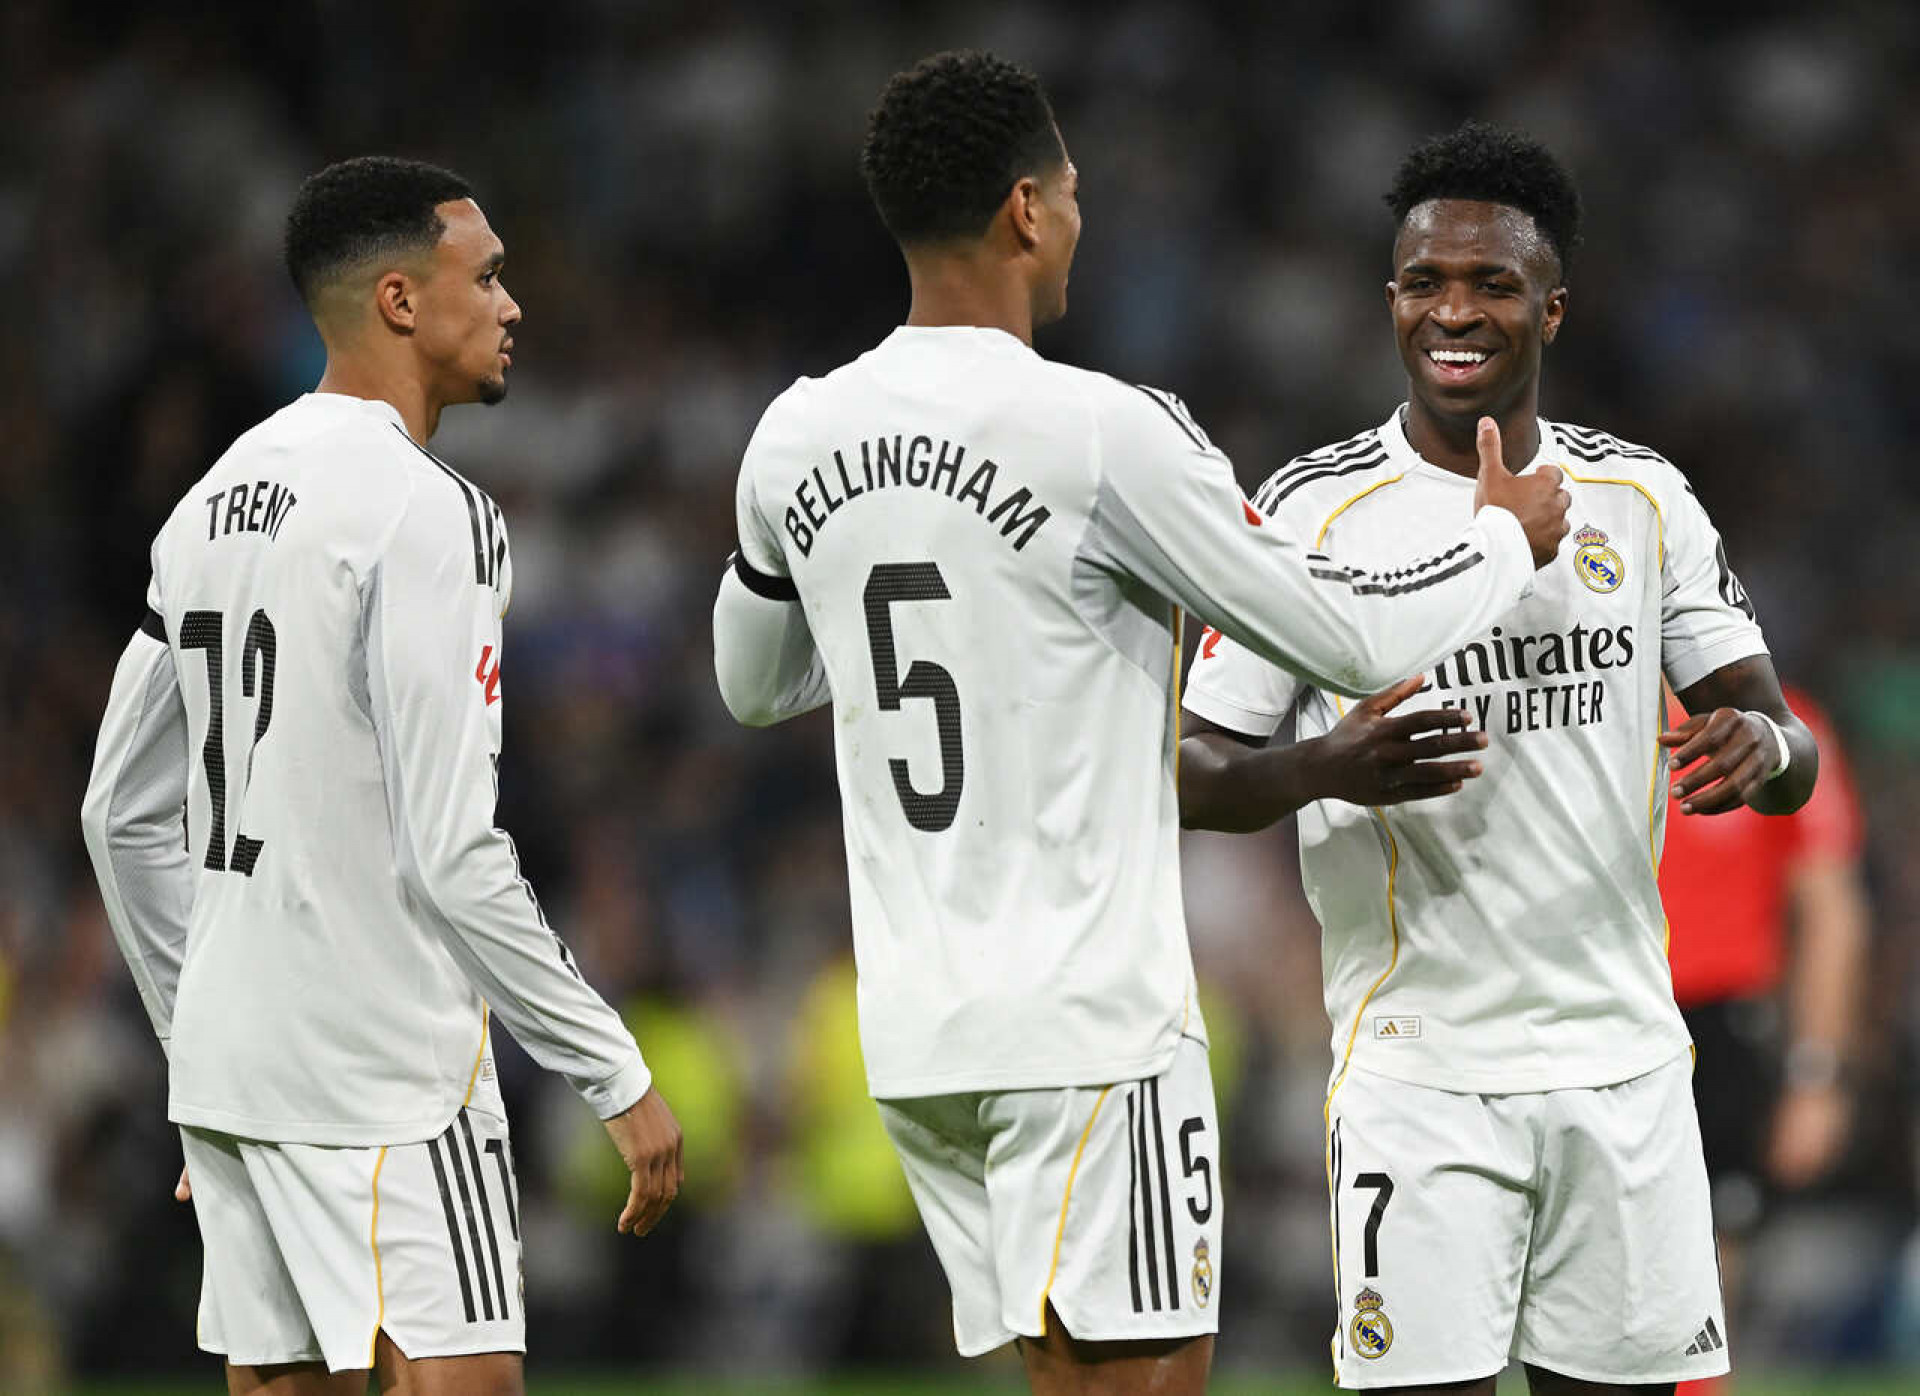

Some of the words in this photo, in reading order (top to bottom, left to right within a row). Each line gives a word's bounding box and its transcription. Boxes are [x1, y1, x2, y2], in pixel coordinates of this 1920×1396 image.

[206, 481, 297, 543] TRENT
[786, 435, 1051, 558] BELLINGHAM
[864, 562, 963, 832] 5
[1415, 622, 1633, 693] mirates
[1507, 680, 1604, 734] BETTER
[180, 609, 276, 877] 12
[485, 1139, 519, 1241] 1
[1179, 1117, 1213, 1225] 5
[1353, 1173, 1395, 1277] 7
